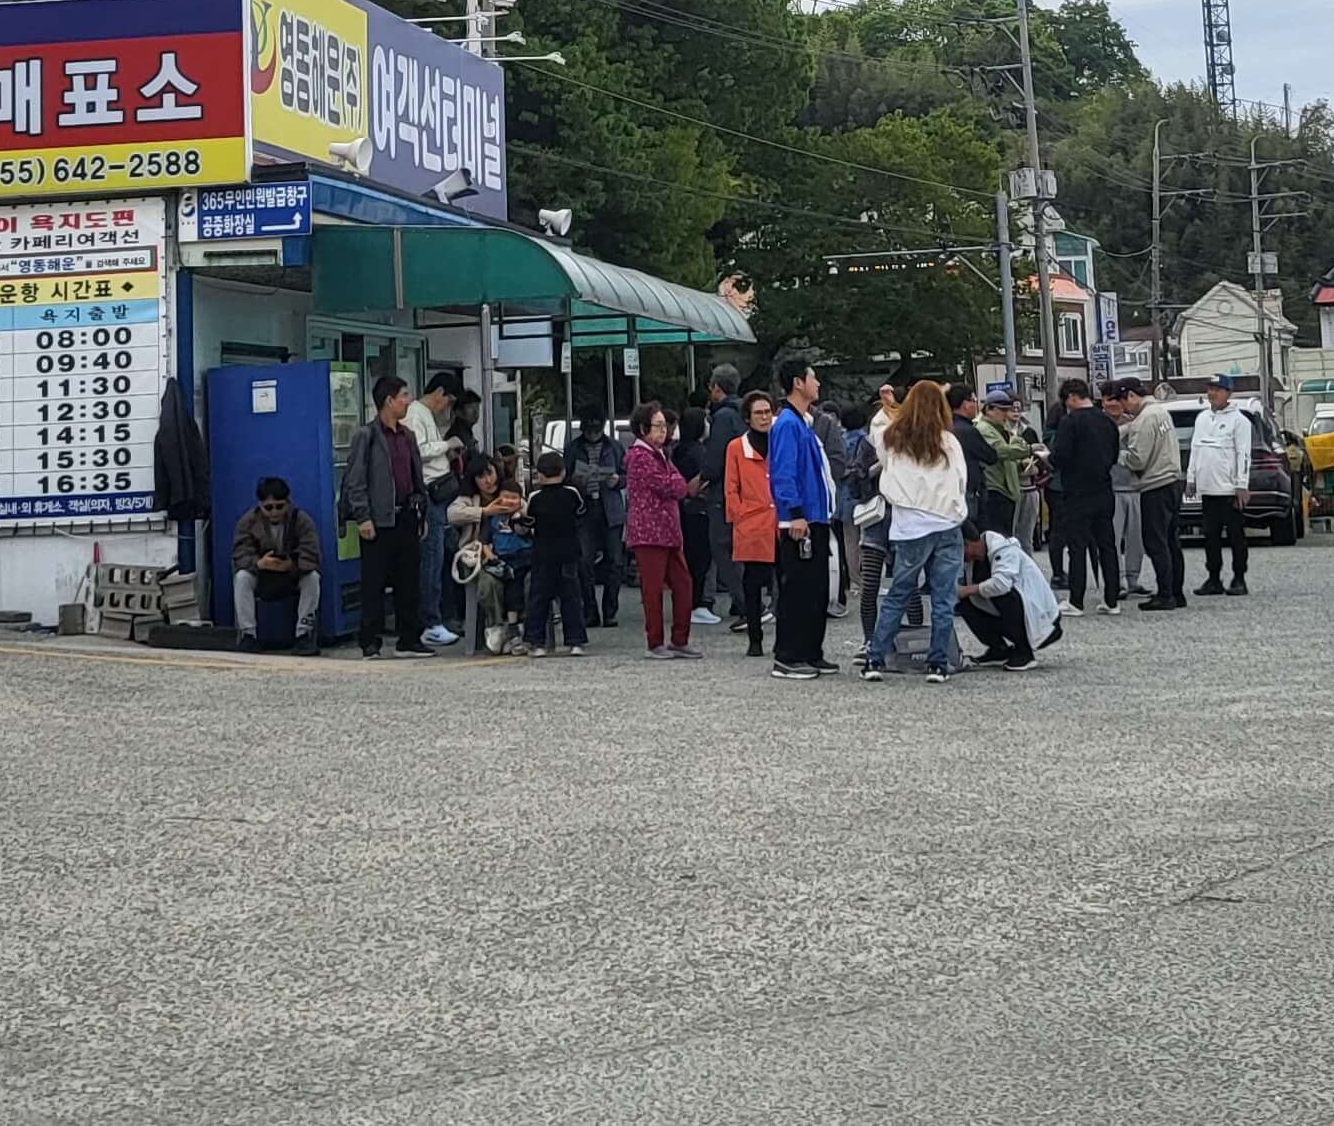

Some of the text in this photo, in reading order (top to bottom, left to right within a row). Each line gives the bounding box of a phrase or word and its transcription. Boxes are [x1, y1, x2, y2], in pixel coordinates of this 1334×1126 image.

[279, 9, 363, 132] 영동해운(주)
[372, 44, 502, 190] 여객선터미널
[202, 186, 308, 210] 365무인민원발급창구
[30, 210, 135, 231] 욕지도편
[202, 213, 255, 237] 공중화장실
[11, 229, 140, 250] 카페리여객선
[0, 282, 40, 304] 운항
[50, 278, 114, 300] 시간표
[36, 327, 132, 349] 08:00
[36, 350, 132, 374] 09:40
[36, 375, 131, 398] 11:30
[37, 400, 131, 422] 12:30
[37, 423, 131, 446] 14:15
[37, 447, 131, 470] 15:30
[37, 472, 132, 494] 16:35
